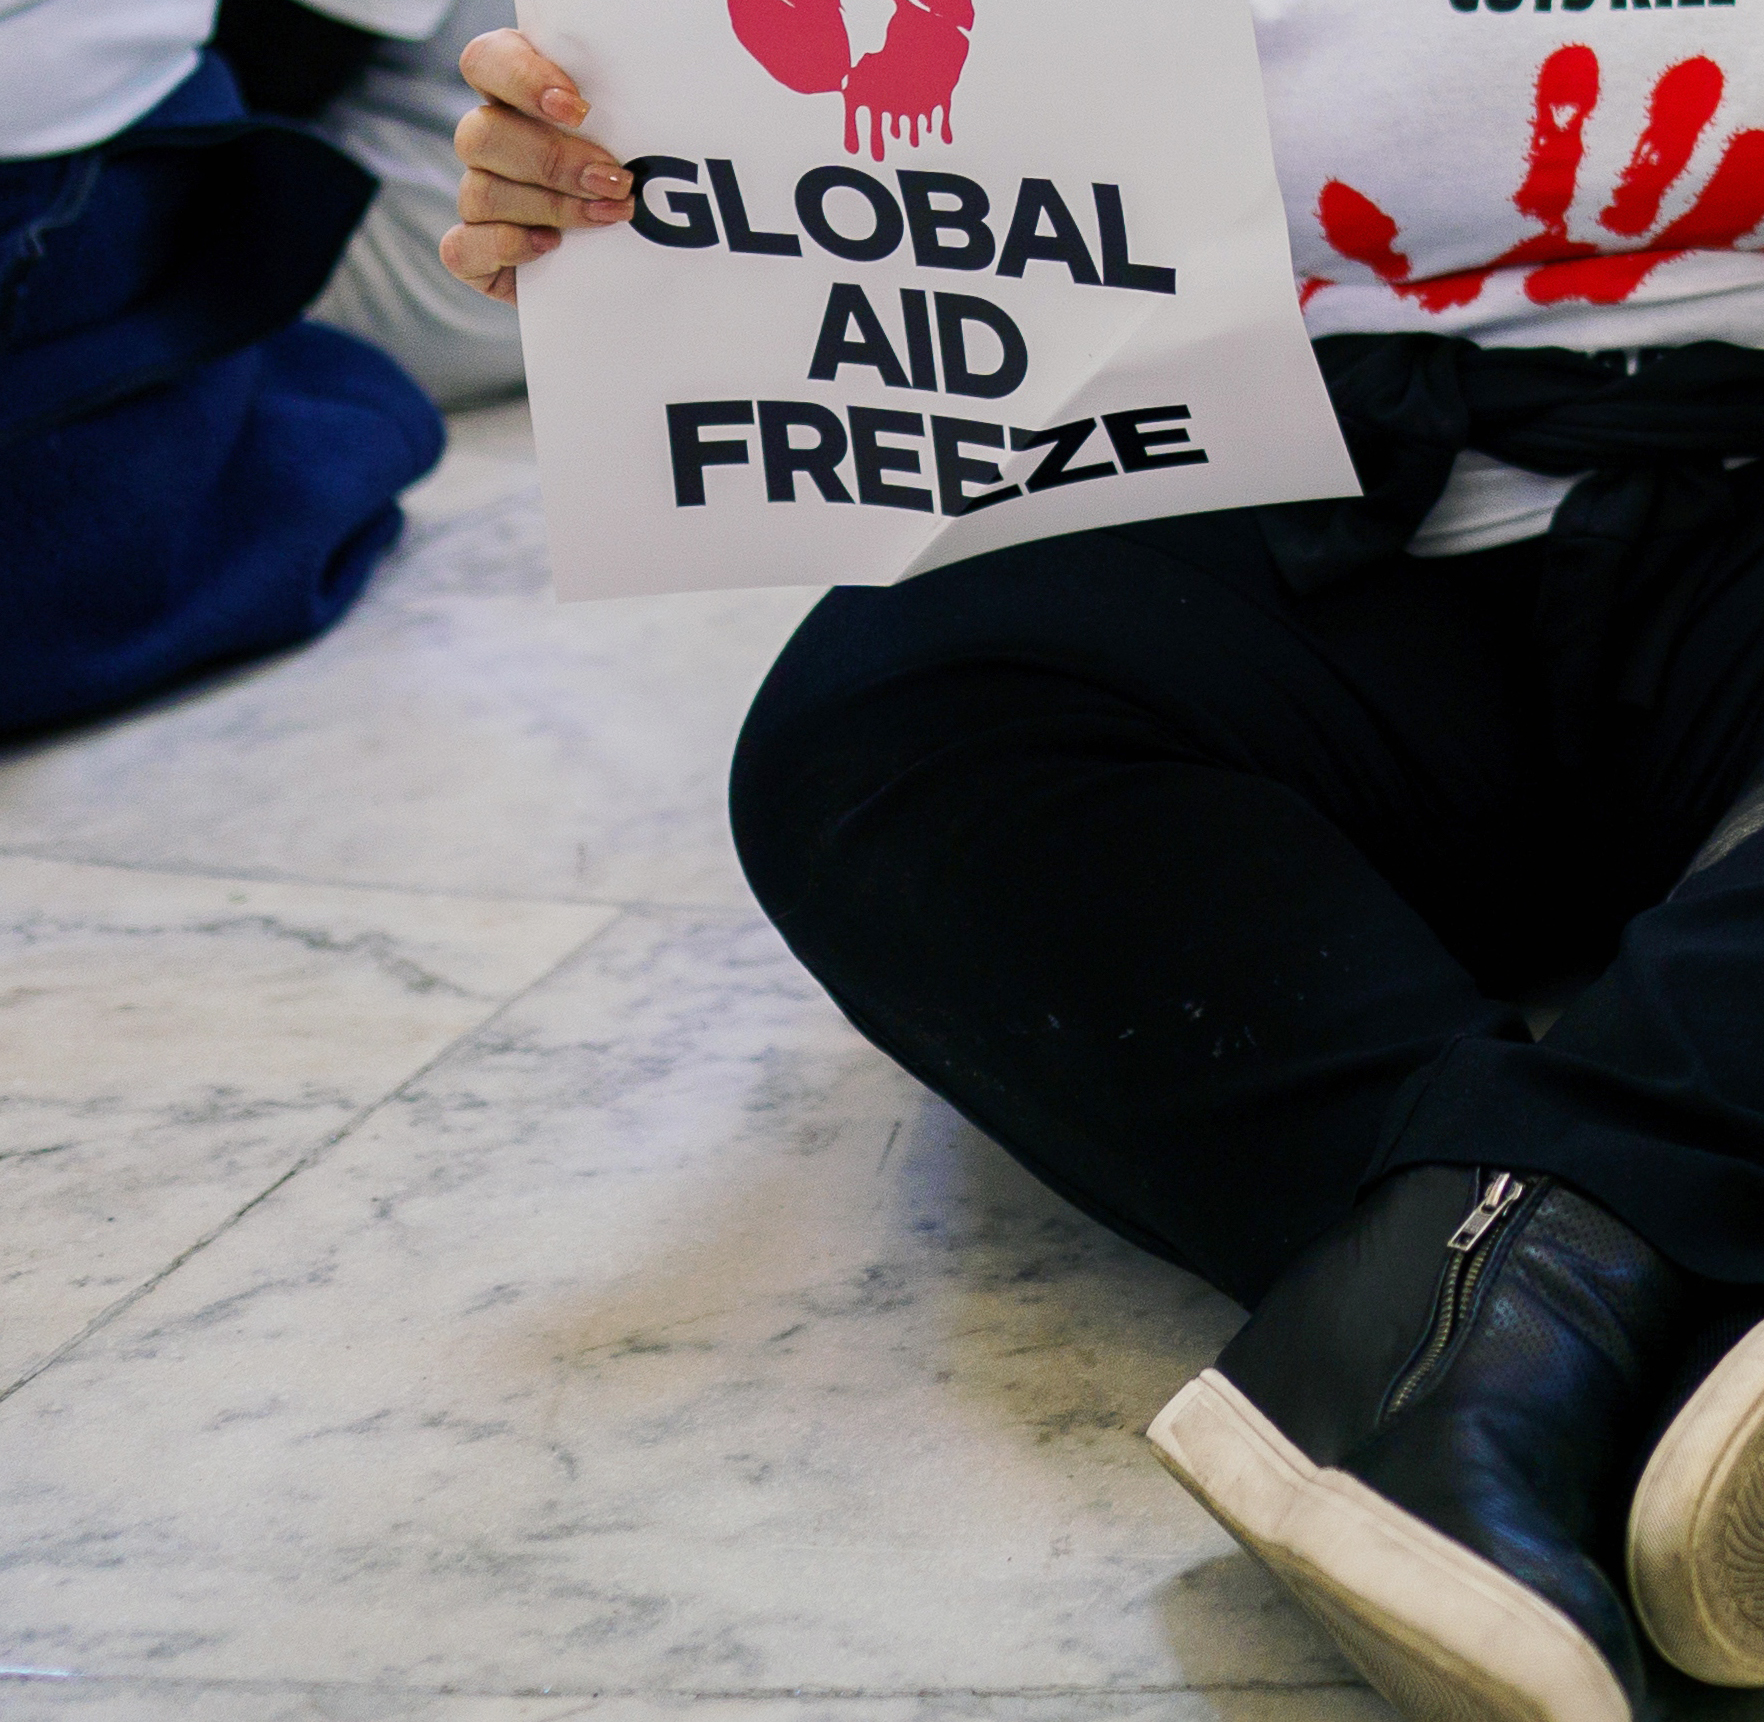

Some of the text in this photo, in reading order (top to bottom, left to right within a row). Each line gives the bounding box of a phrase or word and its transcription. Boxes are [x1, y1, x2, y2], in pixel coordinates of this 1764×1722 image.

[624, 155, 1177, 295] GLOBAL
[807, 282, 1028, 400] AID
[665, 399, 1209, 517] FREEZE
